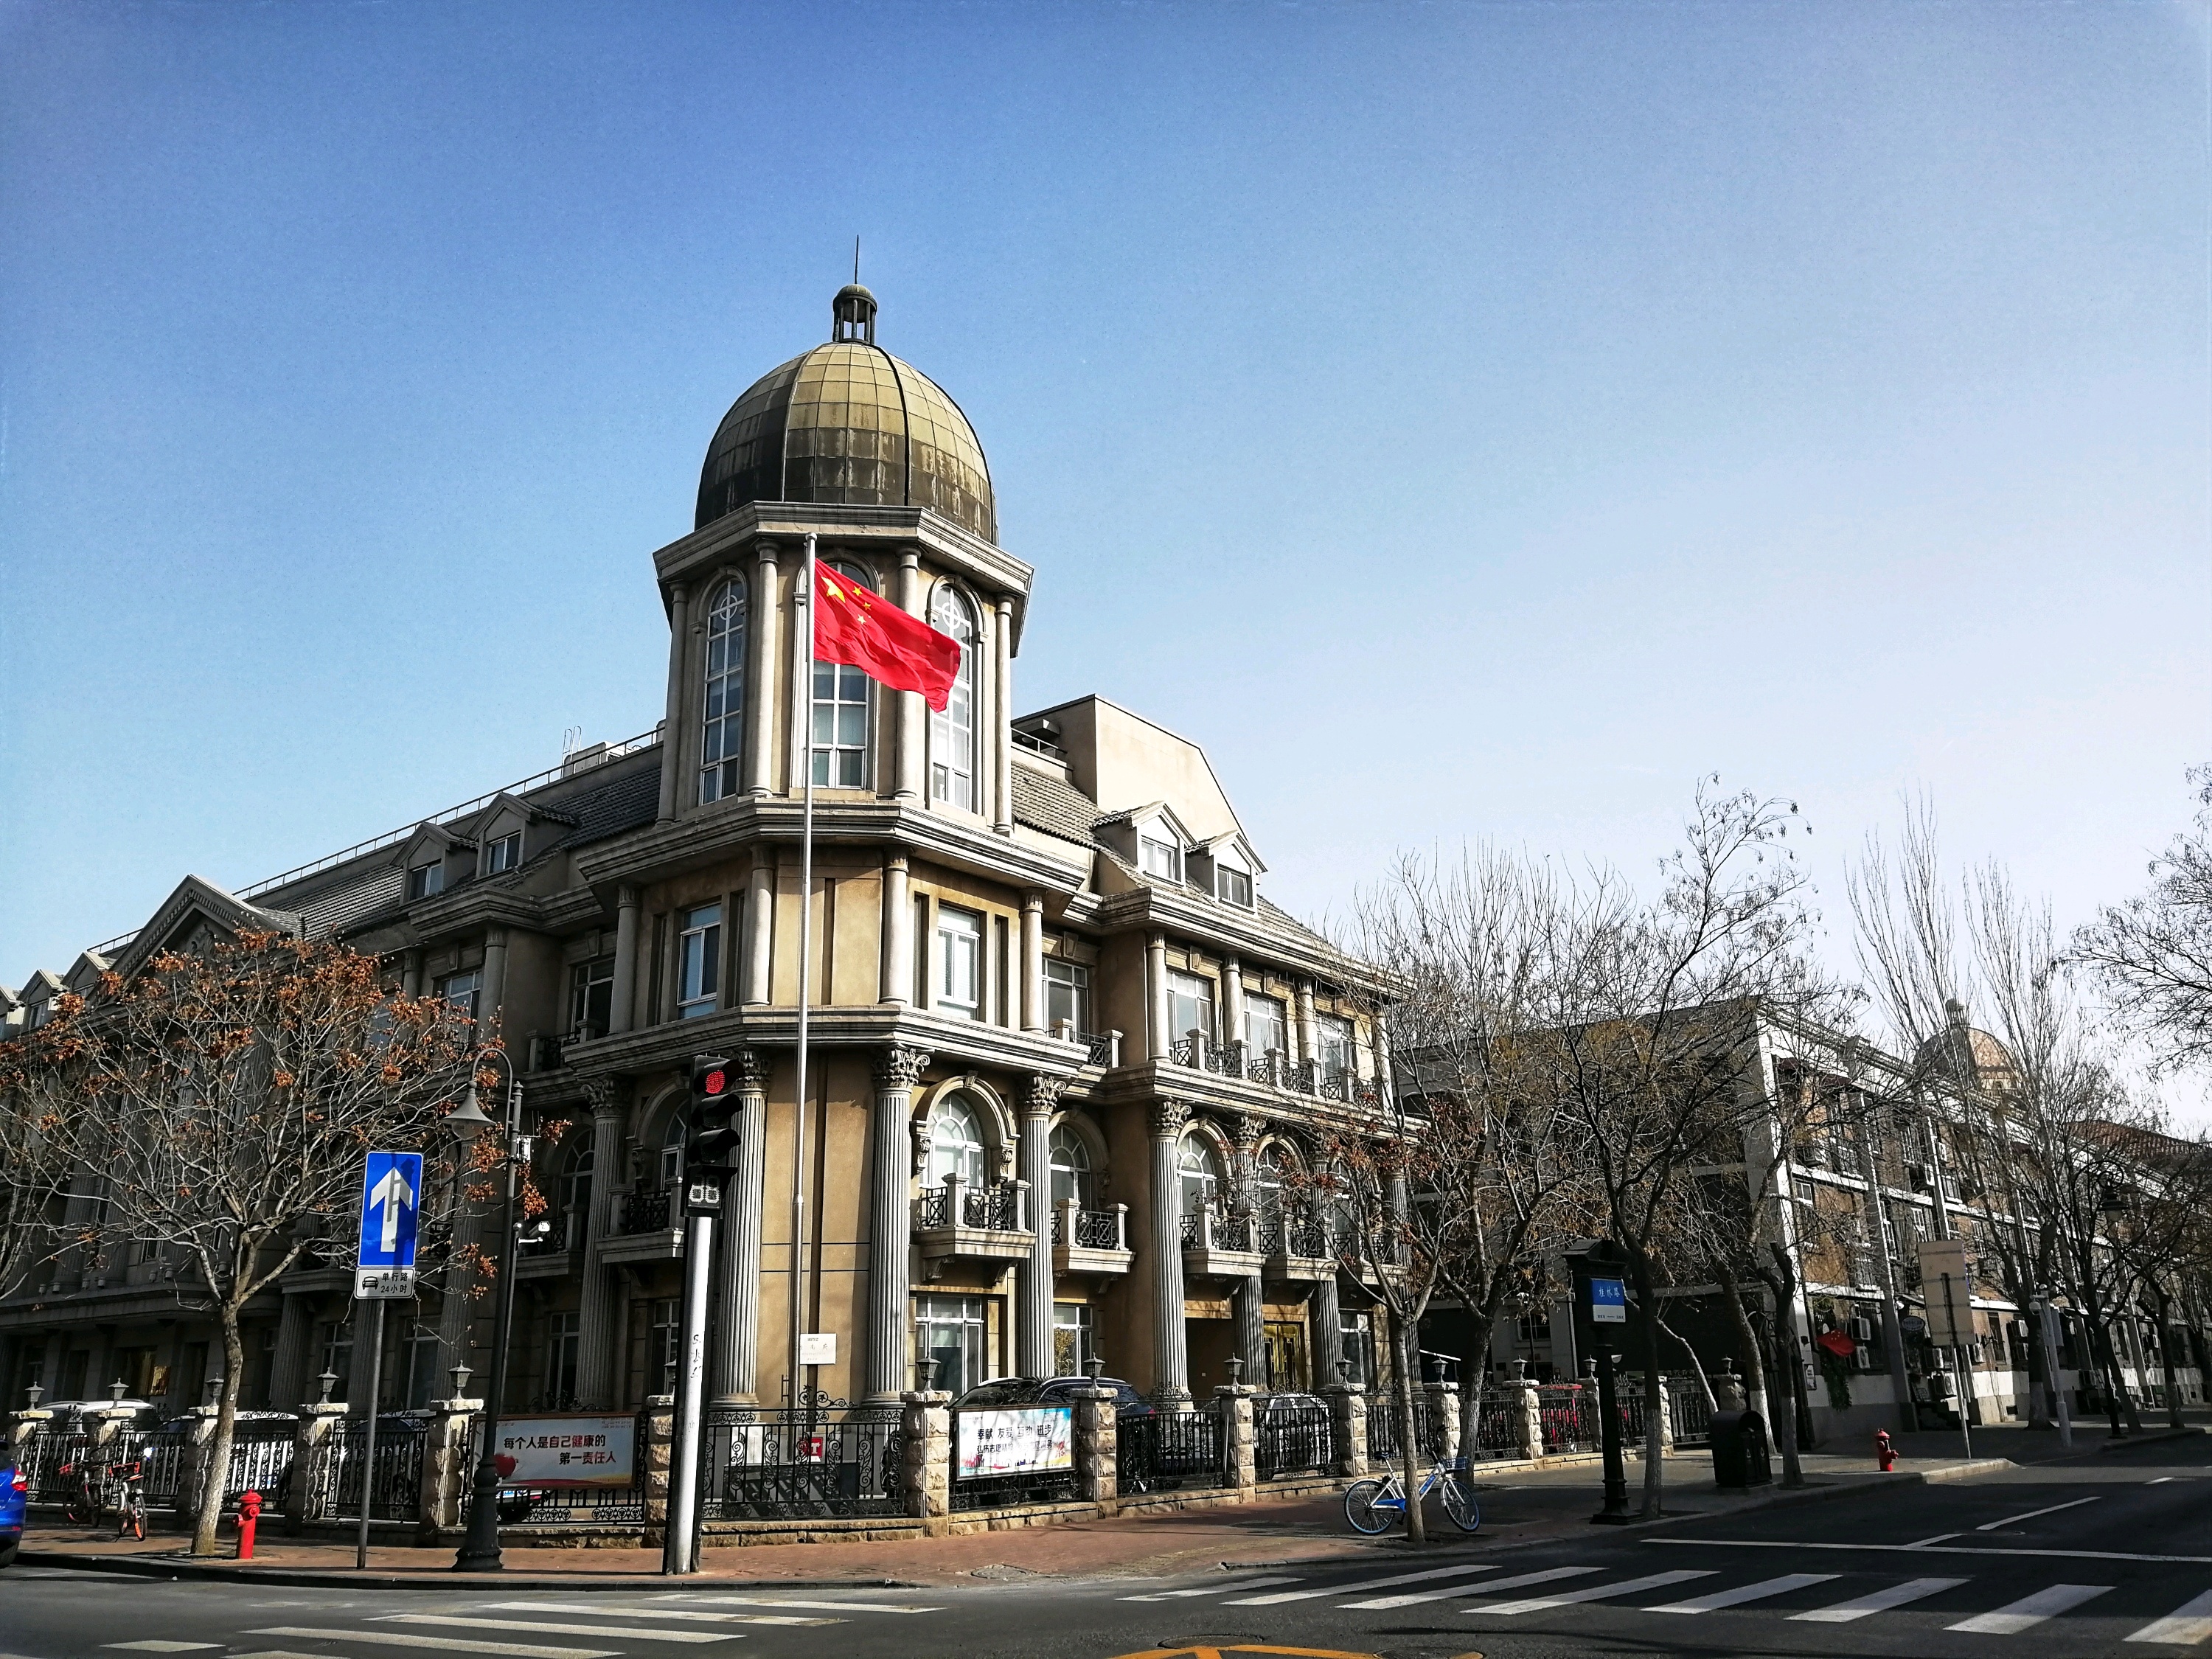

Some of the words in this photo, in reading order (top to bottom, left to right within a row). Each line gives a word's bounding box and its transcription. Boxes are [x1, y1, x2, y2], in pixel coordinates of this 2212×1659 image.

[382, 1272, 408, 1281] 单行路
[380, 1284, 407, 1293] 24小时
[977, 1427, 993, 1440] 奉献
[998, 1426, 1014, 1439] 友爱
[1037, 1424, 1052, 1436] 进步
[504, 1434, 606, 1450] 每个人是自己健康的
[559, 1450, 616, 1466] 第一责任人
